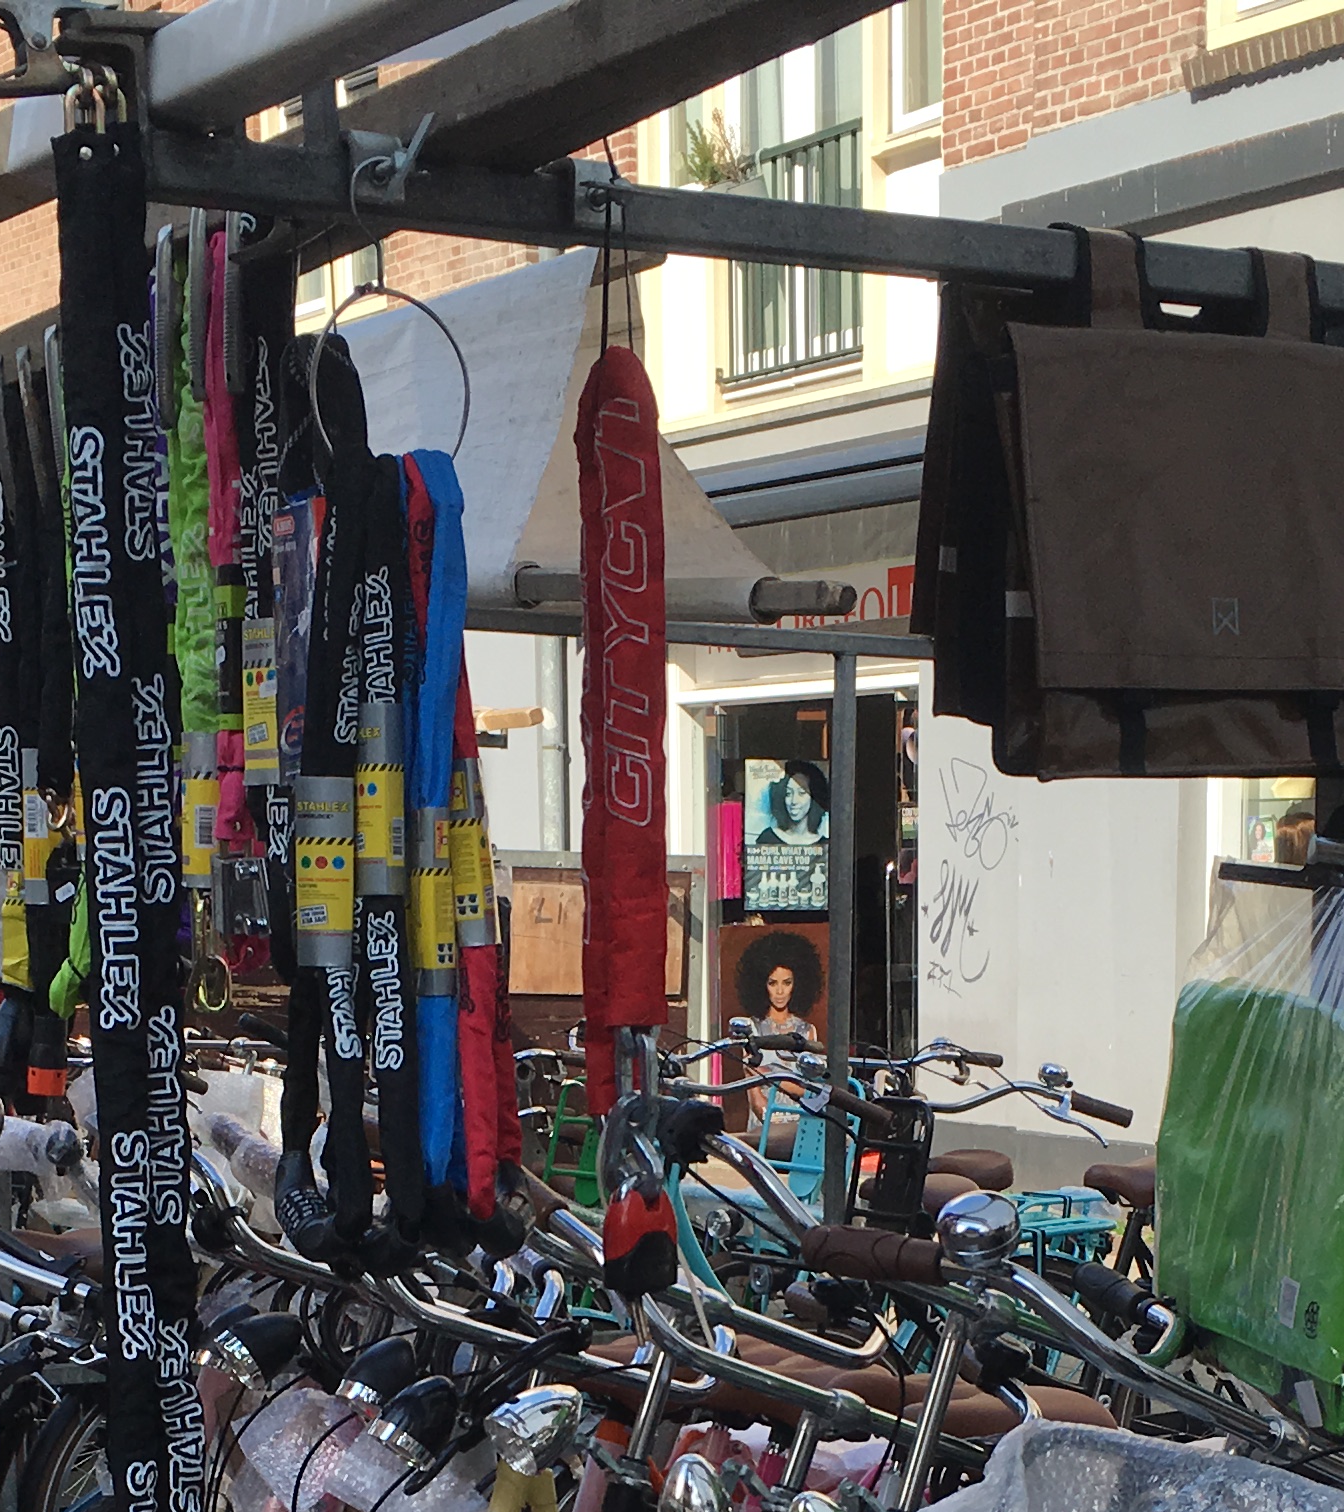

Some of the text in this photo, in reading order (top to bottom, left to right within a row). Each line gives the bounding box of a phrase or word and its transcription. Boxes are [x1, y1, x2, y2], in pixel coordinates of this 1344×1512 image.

[69, 425, 121, 679] STAHLEX
[116, 320, 156, 561] STAHLEX
[364, 565, 396, 704] TAHLEX
[131, 671, 177, 905] STAHLEX
[92, 786, 143, 1031] STAHLEX
[367, 909, 404, 1071] STAHLEX
[147, 1004, 185, 1226] STAHLEX
[110, 1129, 156, 1361] STAHLEX
